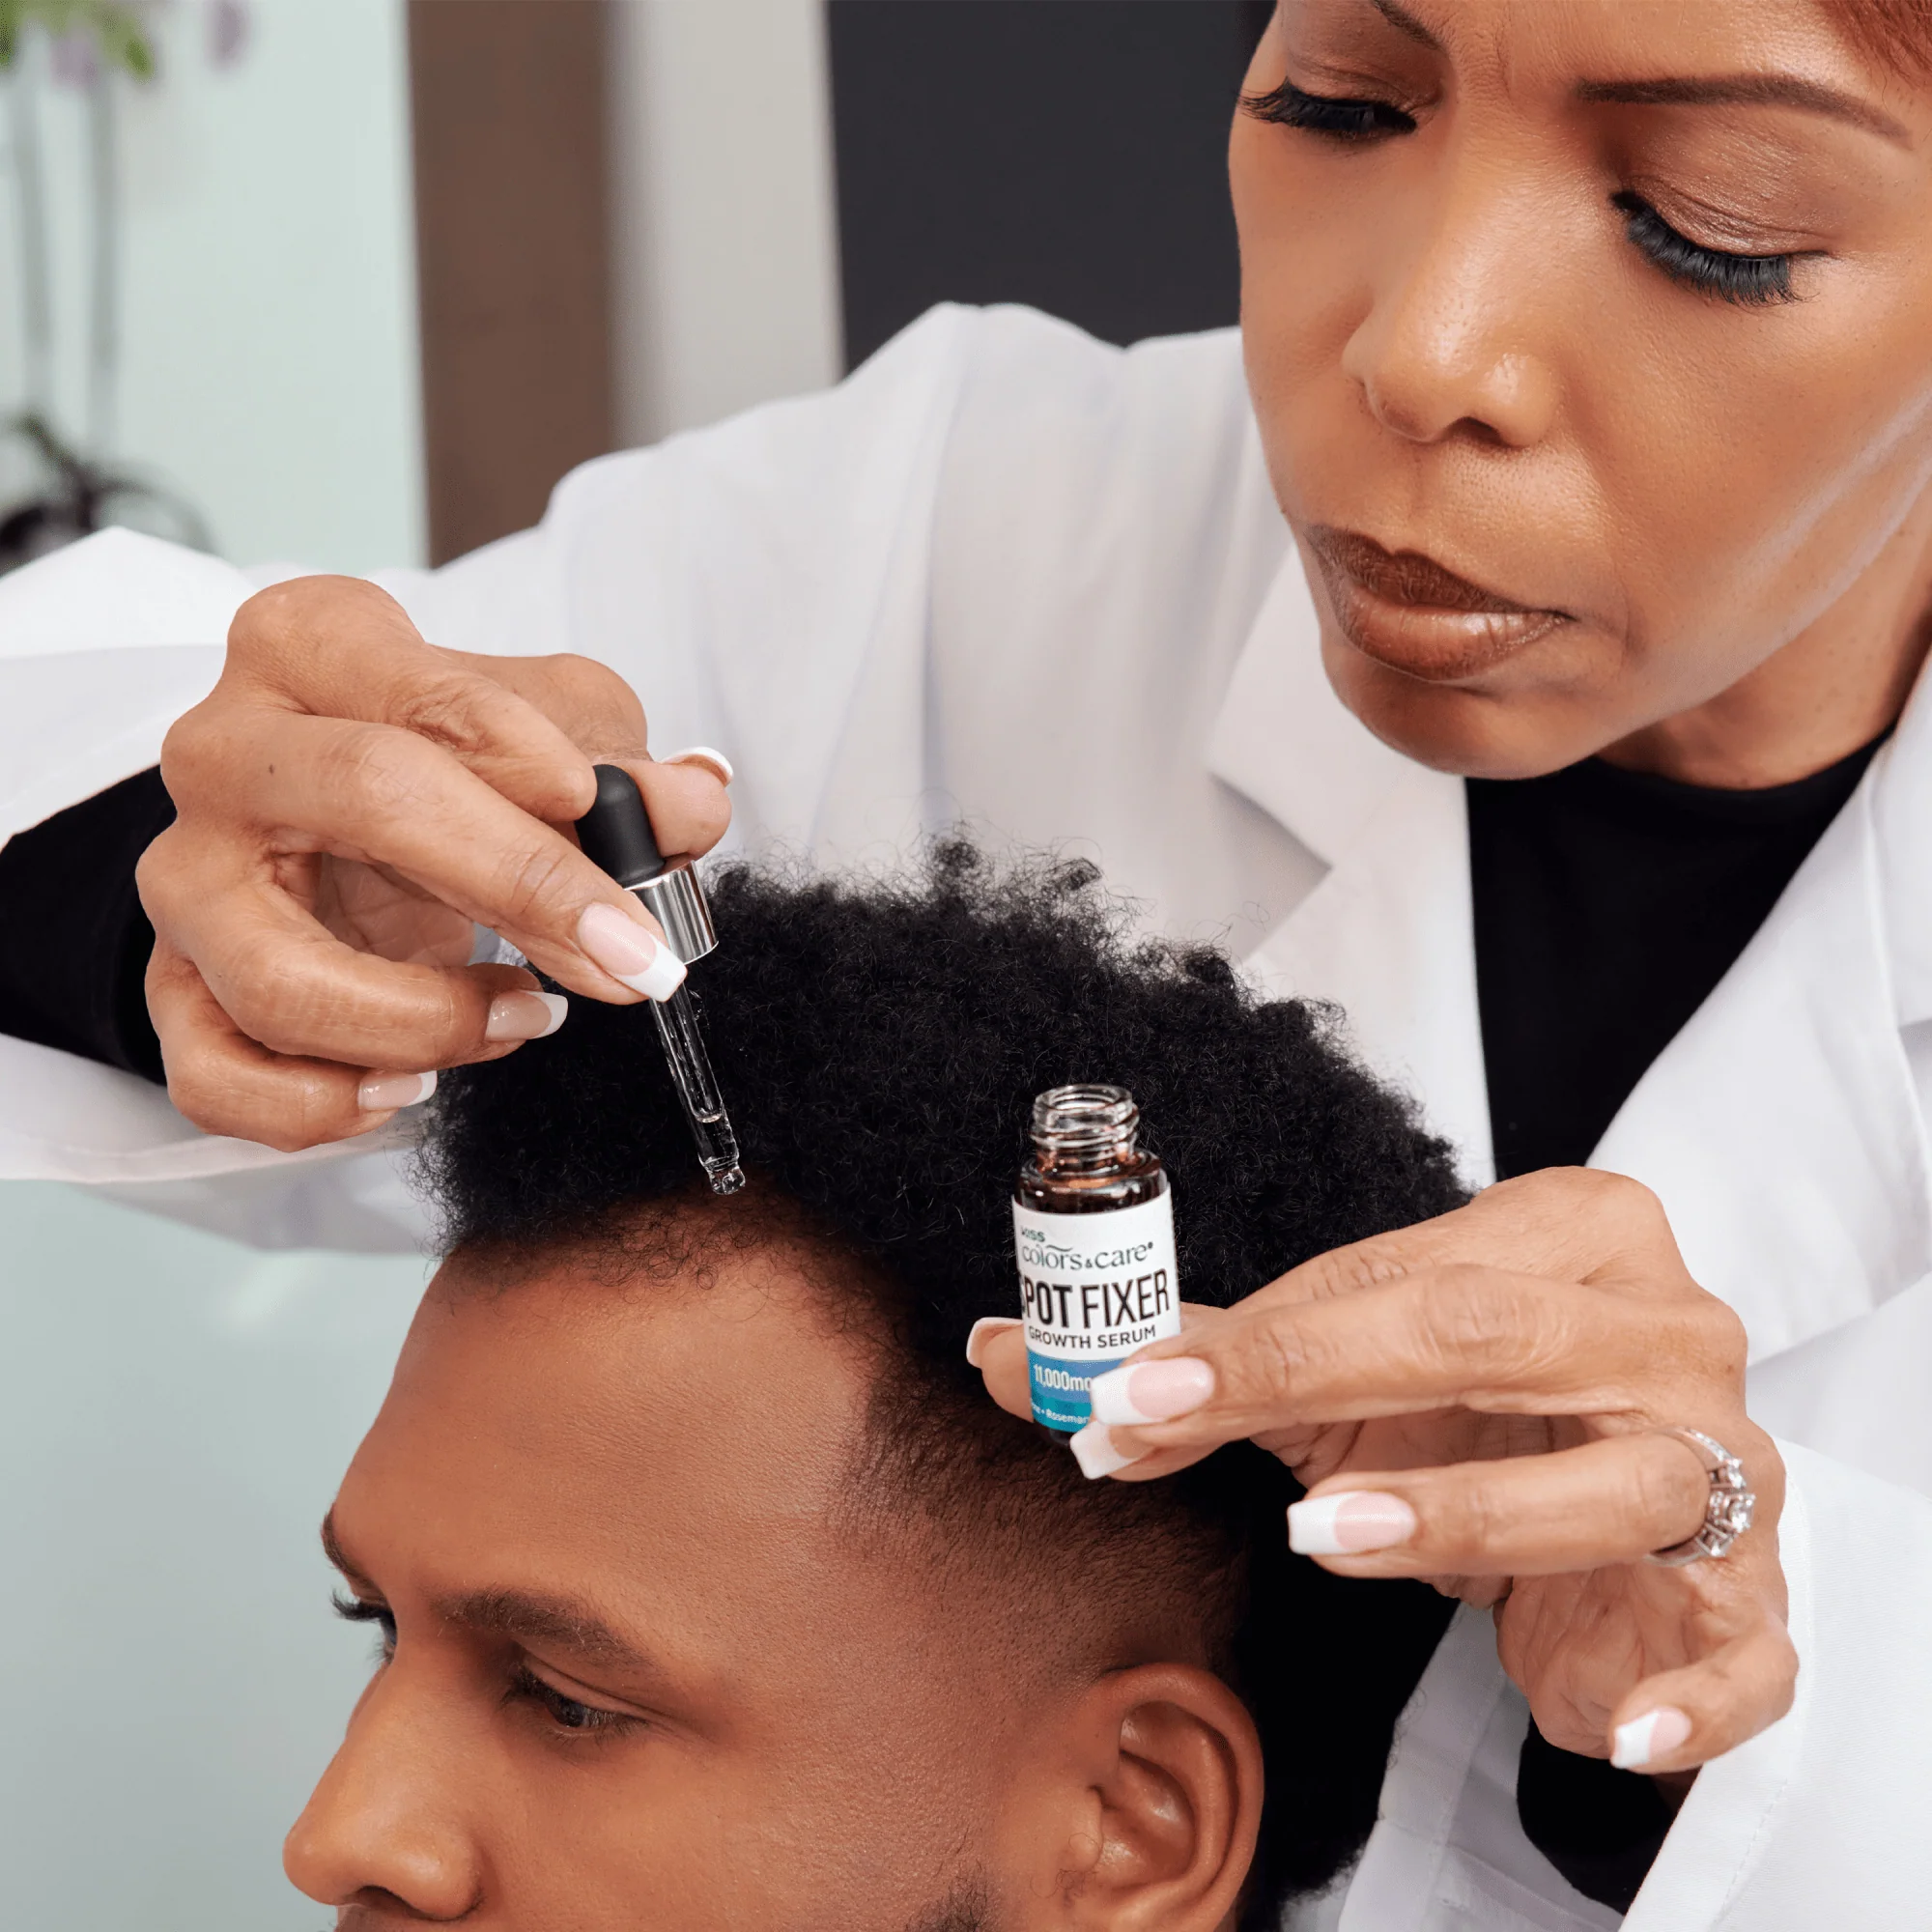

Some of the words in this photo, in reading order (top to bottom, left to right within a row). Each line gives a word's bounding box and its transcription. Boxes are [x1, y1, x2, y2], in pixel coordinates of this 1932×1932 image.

[1021, 1274, 1073, 1328] POT
[1080, 1268, 1170, 1329] FIXER
[1029, 1325, 1092, 1349] GROWTH
[1097, 1324, 1156, 1349] SERUM
[1046, 1408, 1091, 1425] Rosemar
